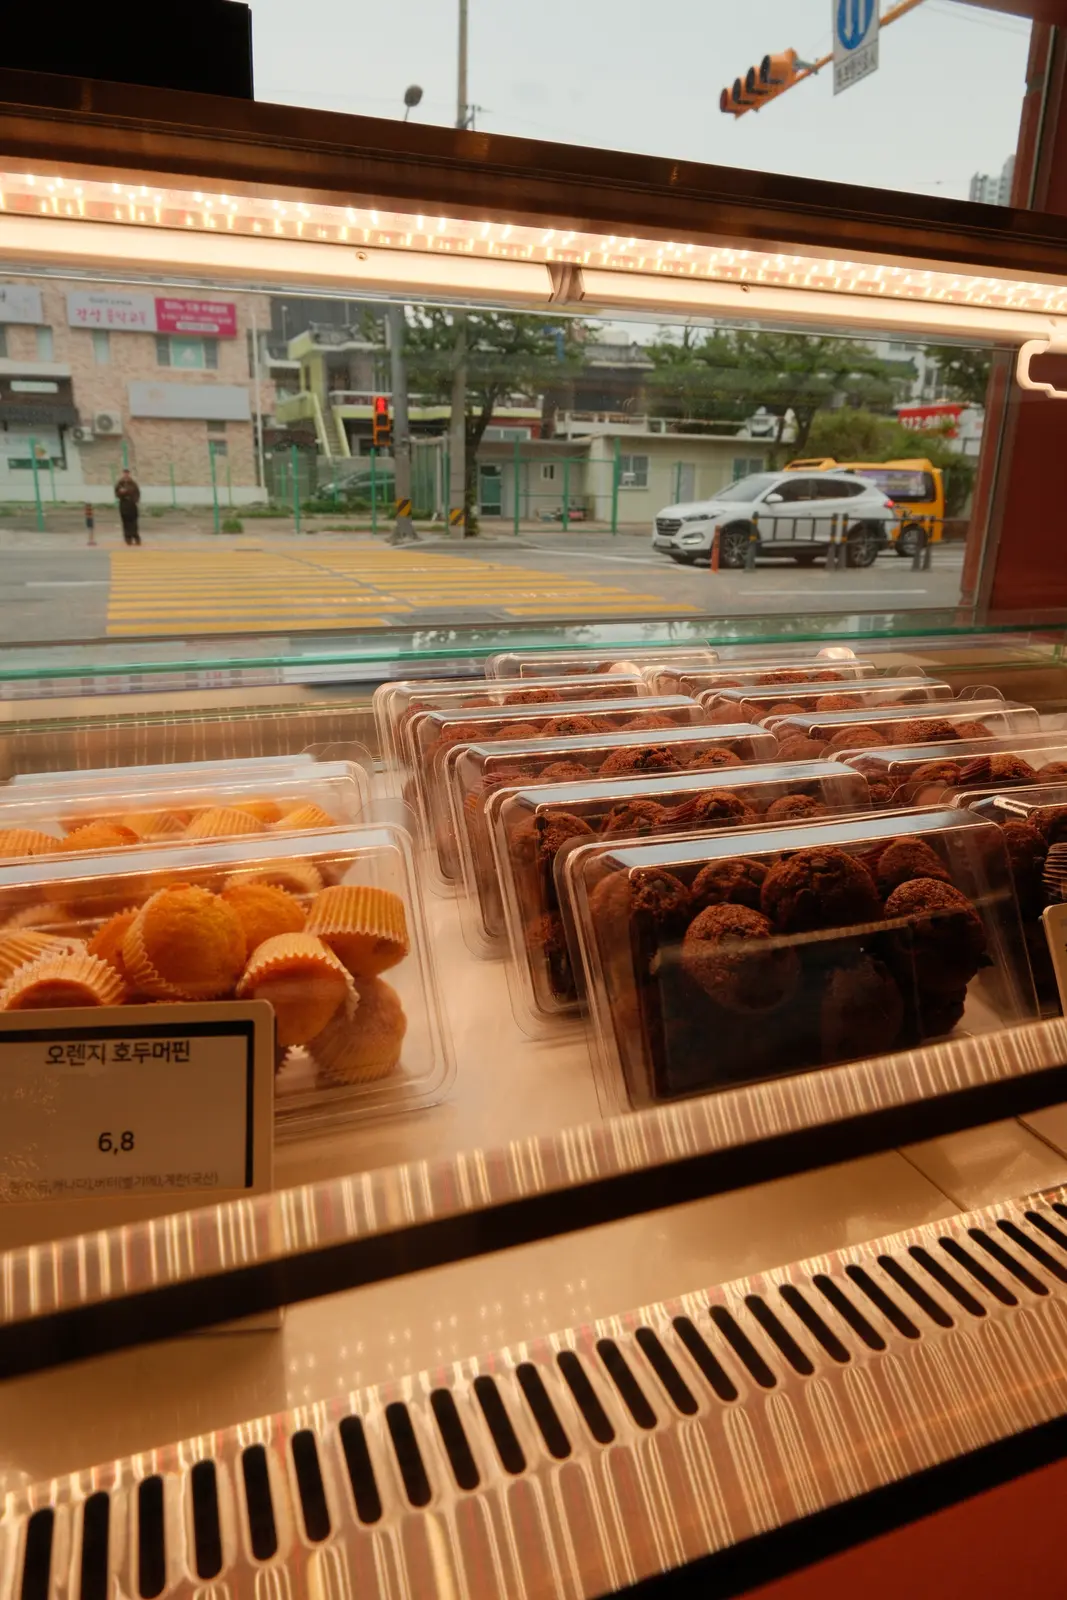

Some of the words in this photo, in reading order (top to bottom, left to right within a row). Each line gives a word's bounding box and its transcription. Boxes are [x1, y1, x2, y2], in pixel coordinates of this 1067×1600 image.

[45, 1043, 106, 1066] 오렌지
[112, 1040, 190, 1063] 호두머핀
[98, 1131, 134, 1155] 6,8
